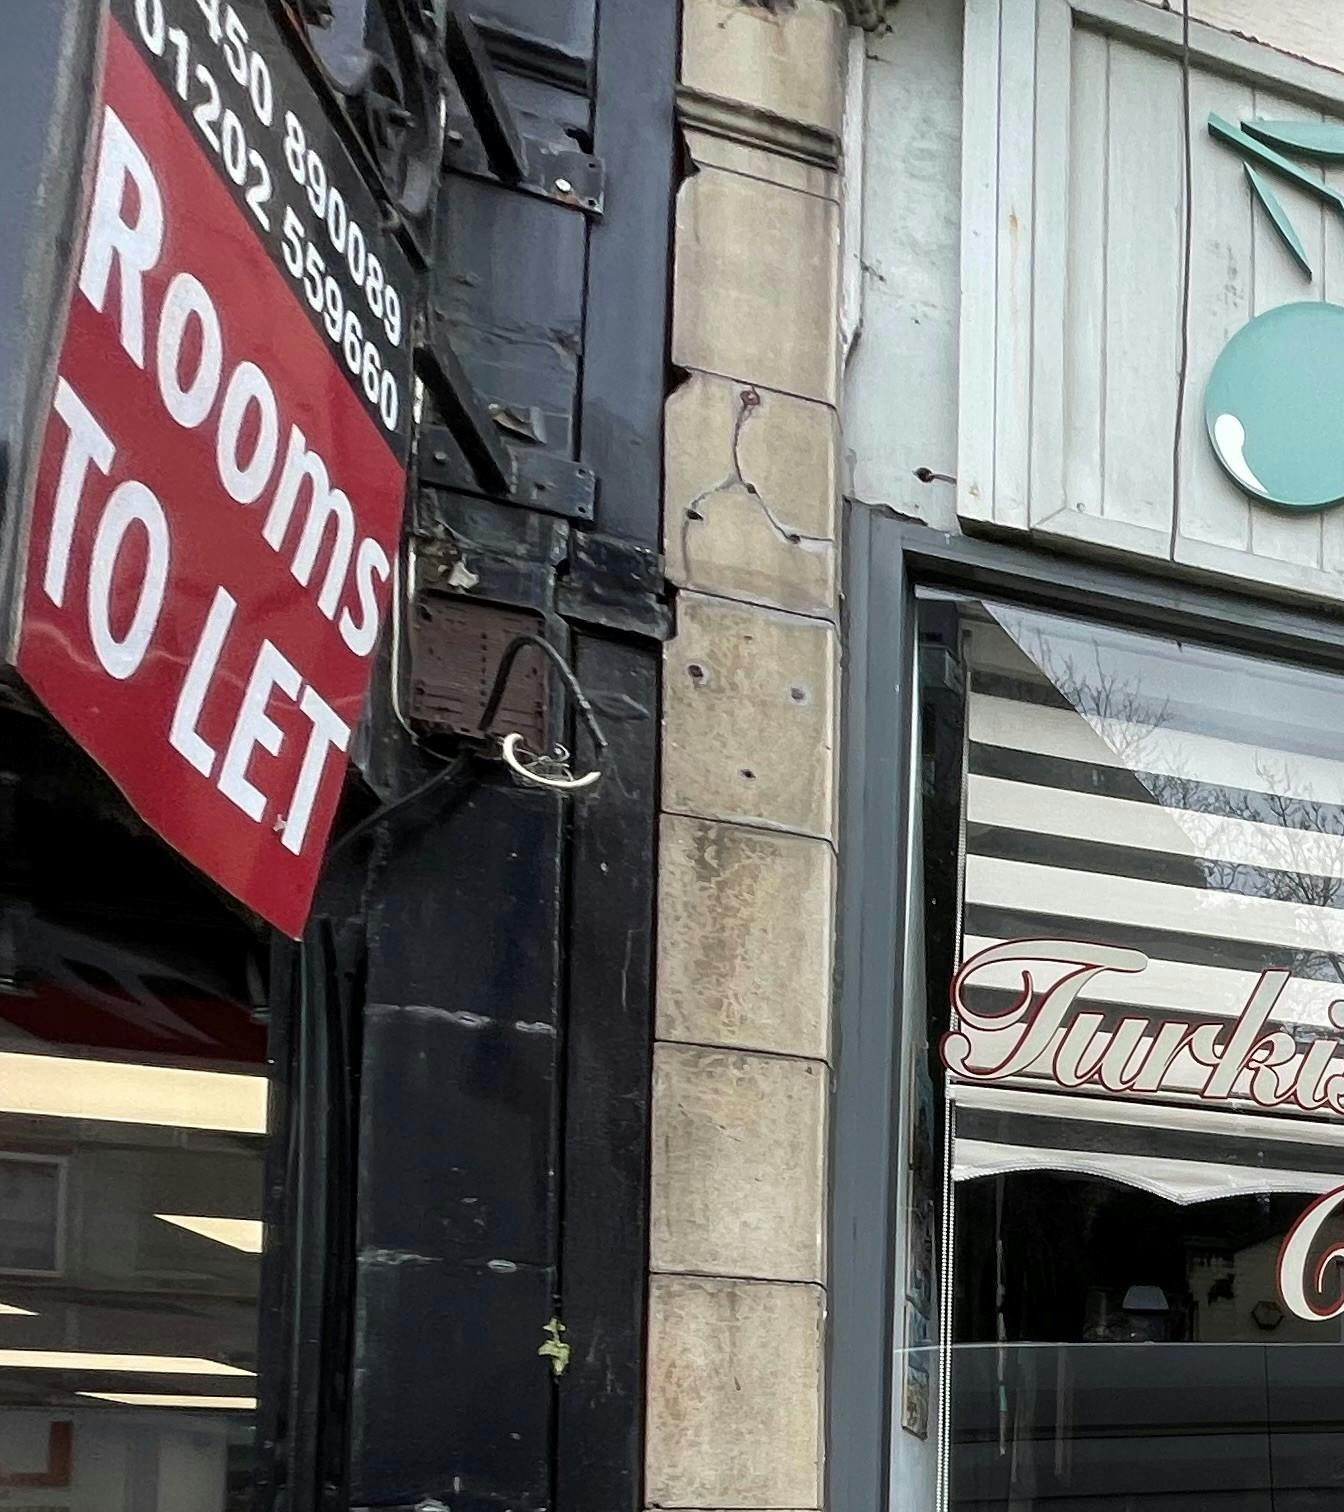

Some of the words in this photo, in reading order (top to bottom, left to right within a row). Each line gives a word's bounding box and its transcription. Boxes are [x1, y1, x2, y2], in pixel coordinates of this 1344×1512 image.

[281, 205, 400, 432] 559660
[283, 110, 402, 348] 890089
[42, 375, 171, 680] TO
[169, 586, 350, 855] LET
